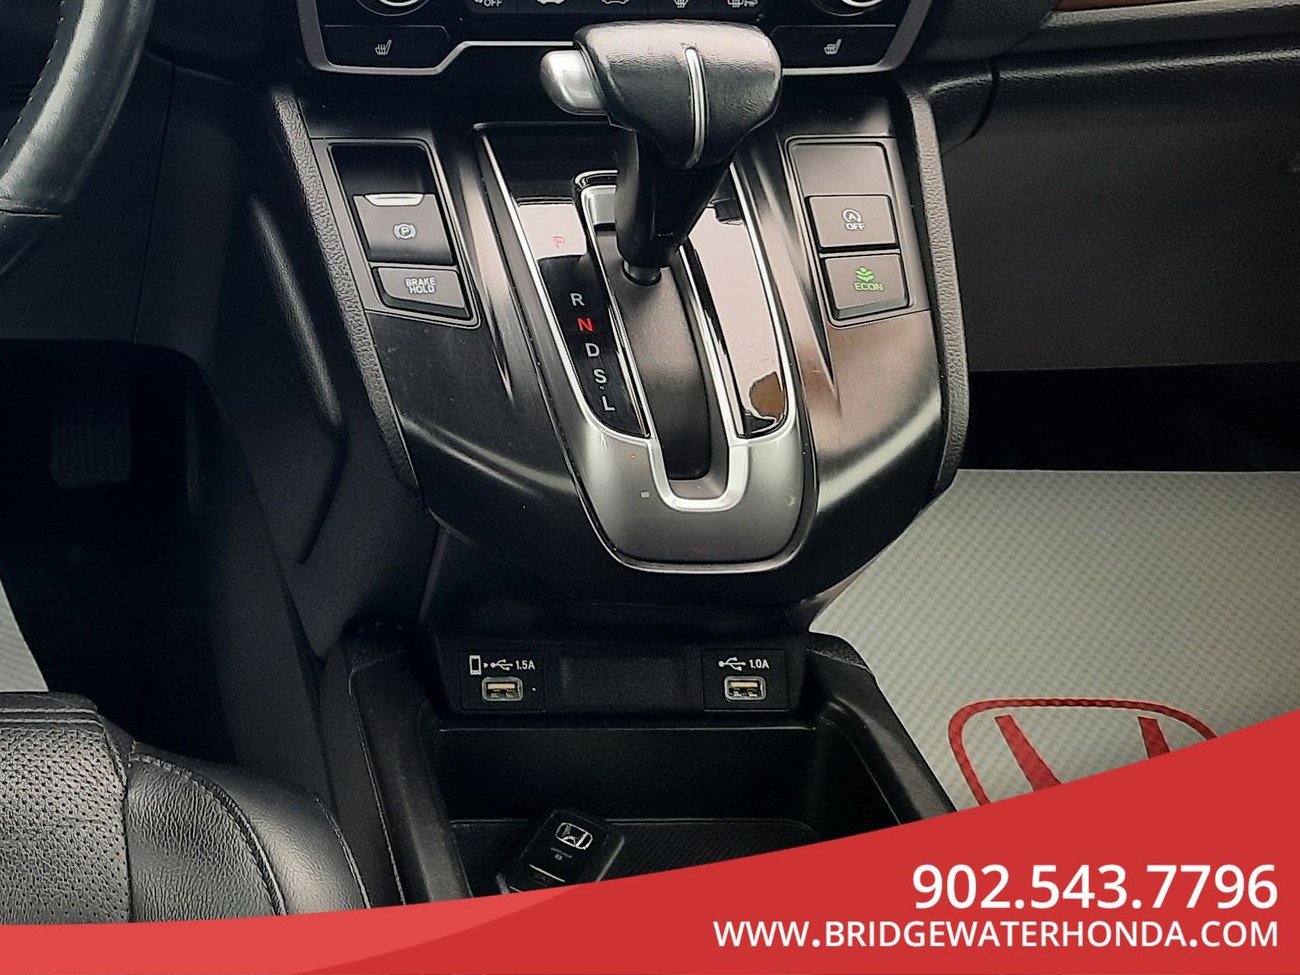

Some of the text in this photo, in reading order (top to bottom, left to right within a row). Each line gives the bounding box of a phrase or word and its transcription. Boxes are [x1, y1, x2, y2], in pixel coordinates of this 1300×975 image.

[845, 222, 865, 230] OFF
[553, 235, 566, 247] P
[405, 277, 436, 287] BRAKE
[854, 282, 884, 291] ECON
[409, 286, 435, 294] HOLD
[570, 293, 585, 307] R
[577, 318, 594, 332] N
[585, 343, 600, 357] D
[594, 368, 608, 384] S
[602, 396, 616, 411] L
[514, 659, 536, 671] 1.5A
[749, 658, 770, 670] 1.0A
